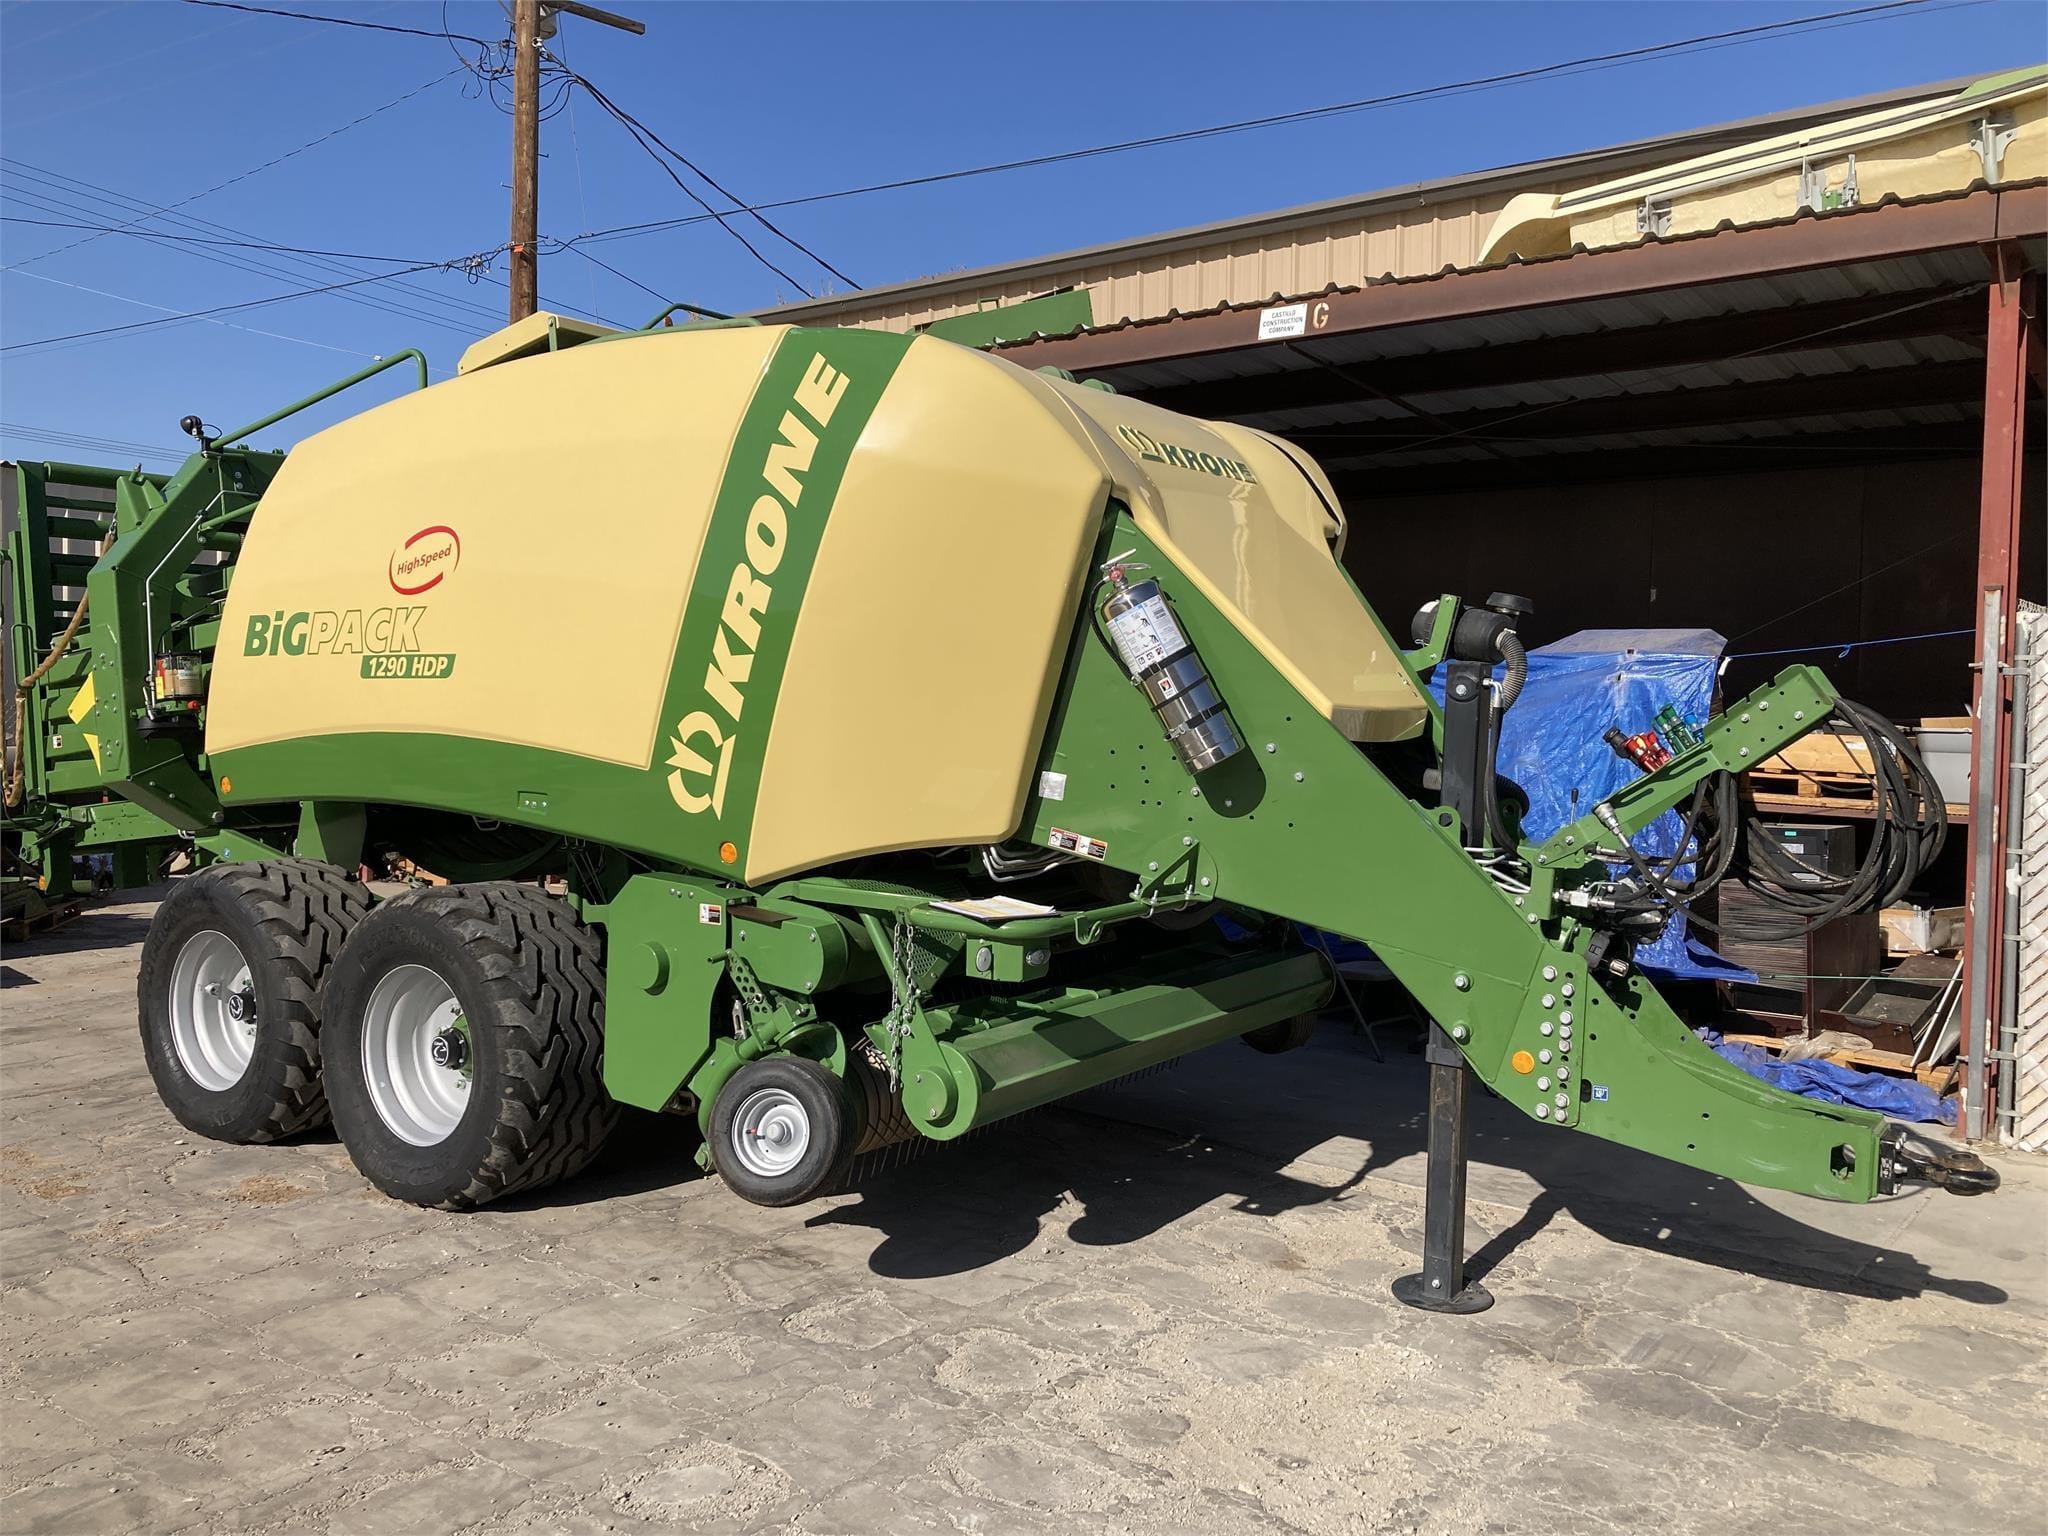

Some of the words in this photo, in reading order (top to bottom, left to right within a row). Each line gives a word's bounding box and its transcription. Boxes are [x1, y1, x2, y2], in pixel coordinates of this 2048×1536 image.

[1262, 316, 1303, 327] CONSTRUCTION
[1312, 302, 1330, 329] G
[1268, 325, 1295, 334] COMPANY
[1156, 441, 1257, 484] KRONE
[703, 351, 851, 722] KRONE
[396, 543, 452, 576] HighSpeed
[368, 656, 407, 678] 1290
[411, 656, 449, 677] HDP
